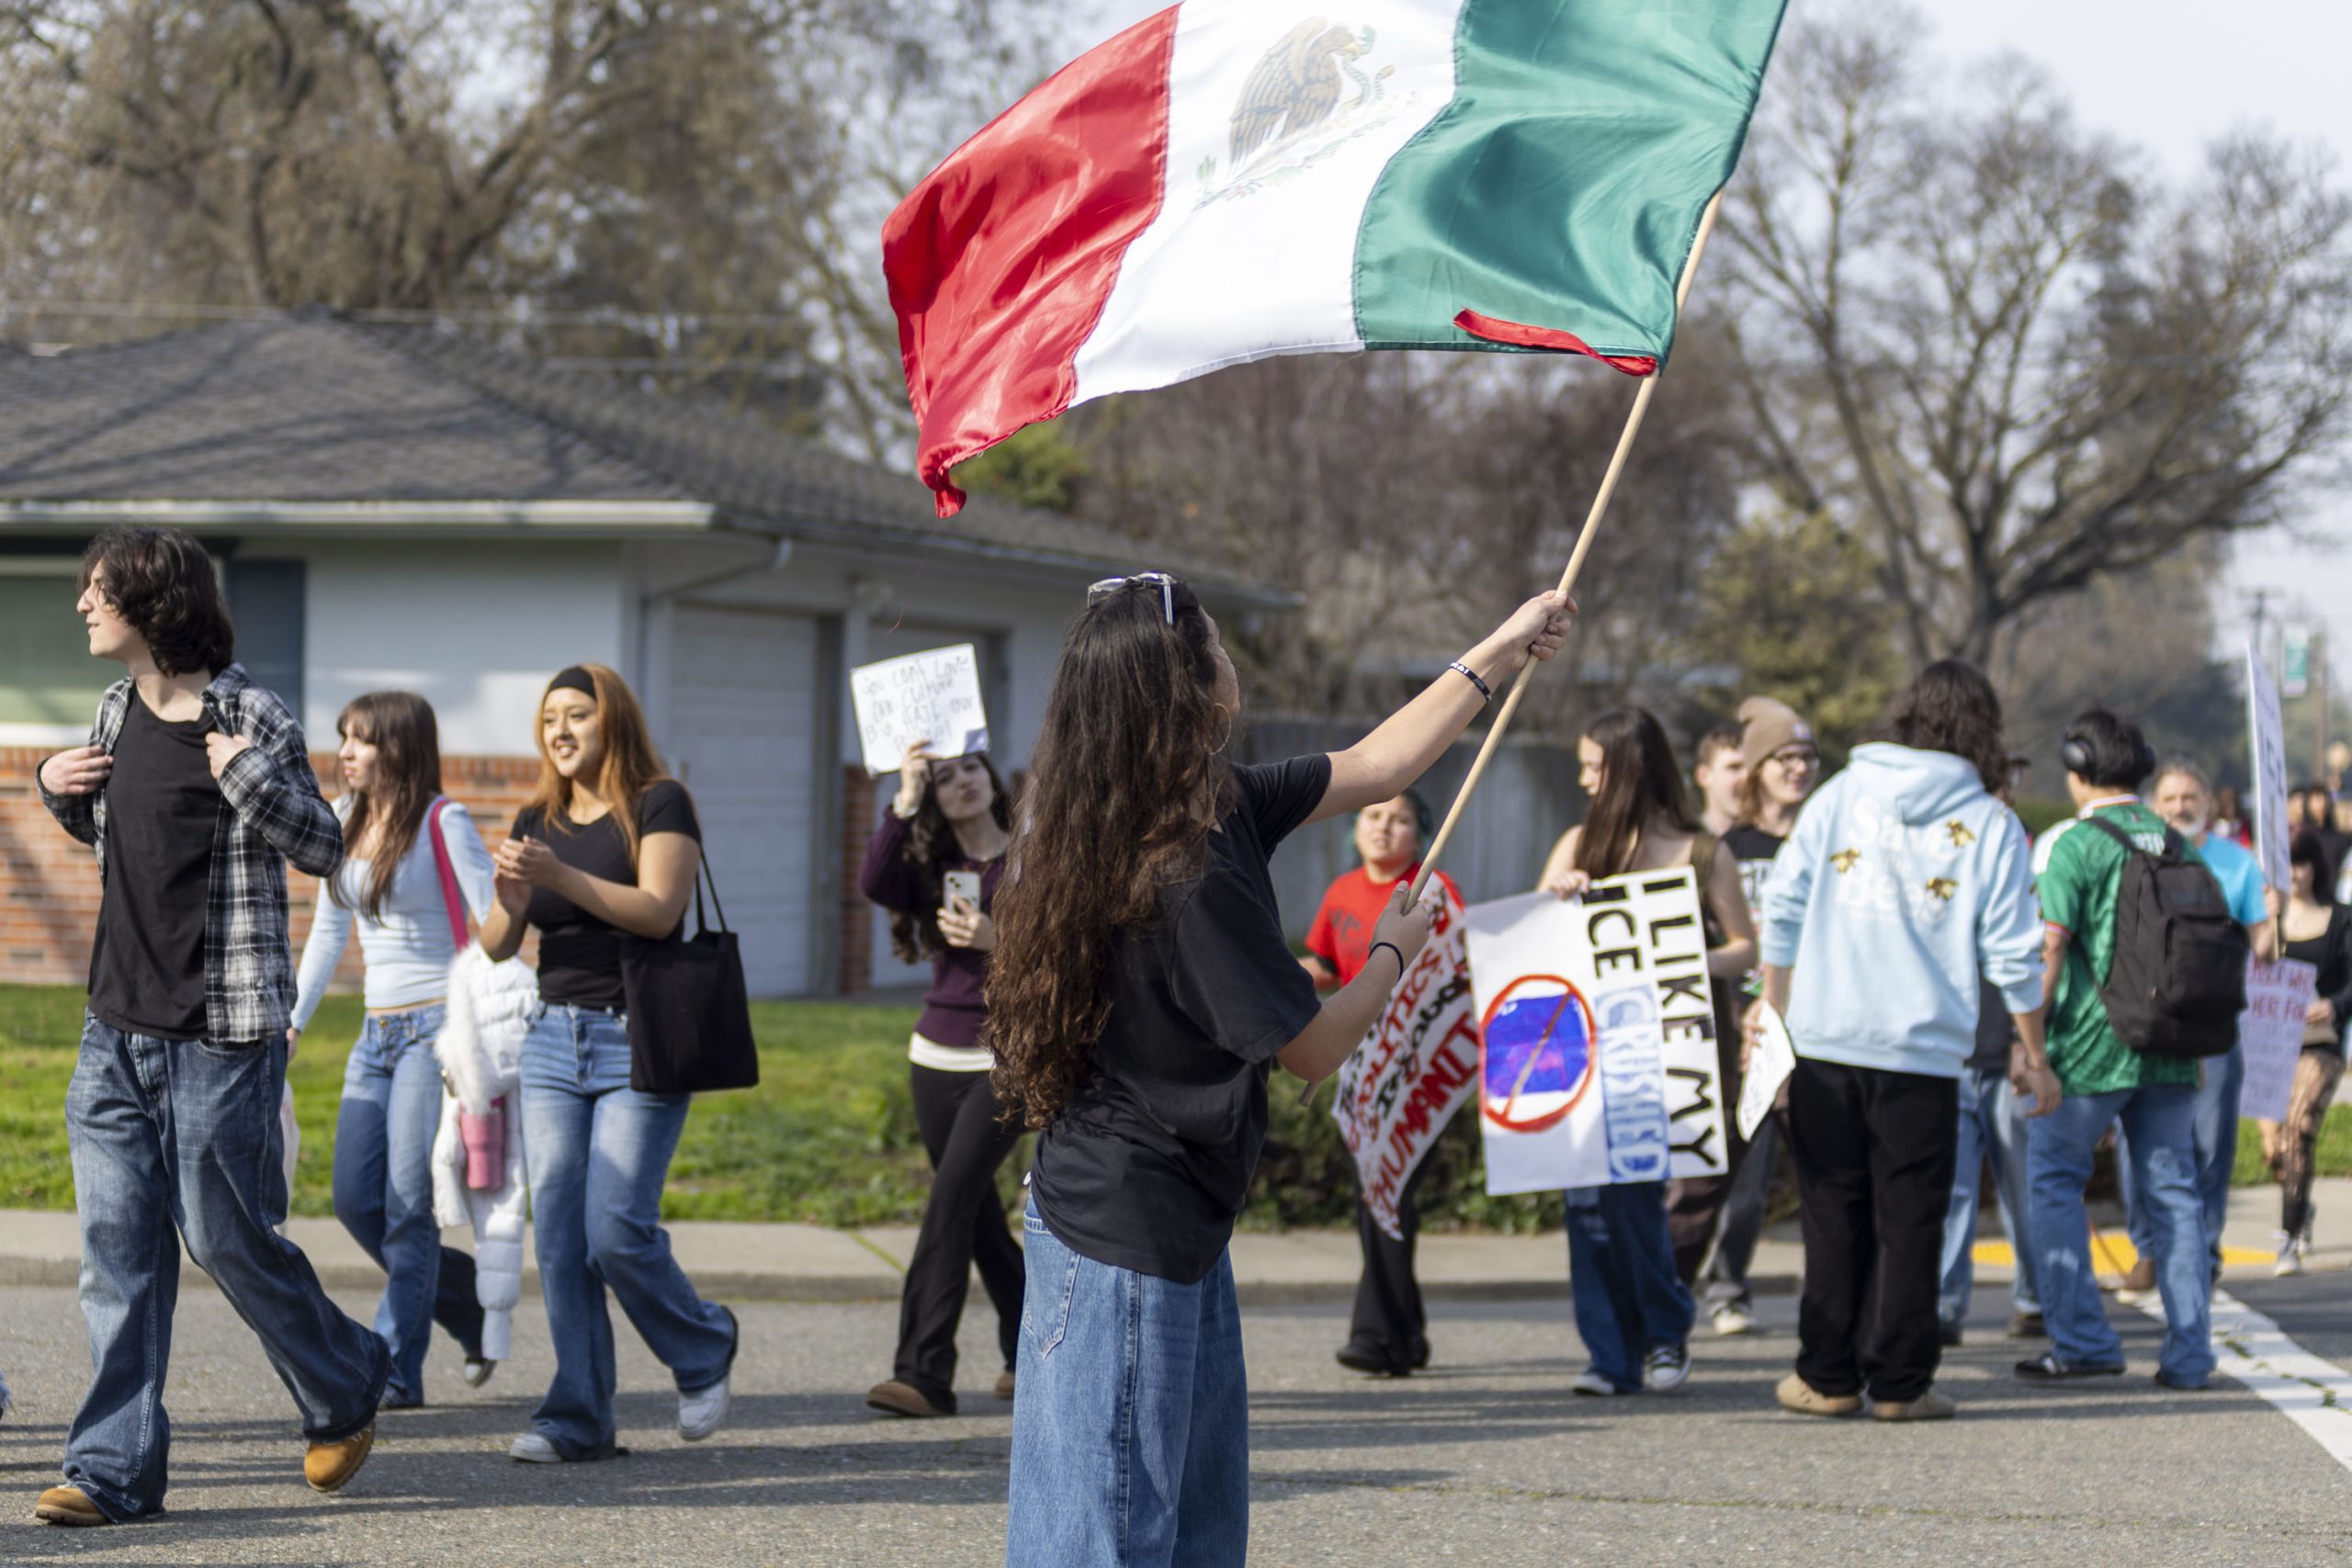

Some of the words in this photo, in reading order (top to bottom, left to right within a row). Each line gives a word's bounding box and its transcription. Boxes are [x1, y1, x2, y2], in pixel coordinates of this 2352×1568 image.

[1582, 884, 1643, 979] ICE
[1643, 876, 1689, 893] I
[1650, 914, 1717, 1043] LIKE
[1378, 1010, 1480, 1200] HUMANIT
[1596, 987, 1670, 1183] CRUSHED
[1665, 1067, 1719, 1168] MY
